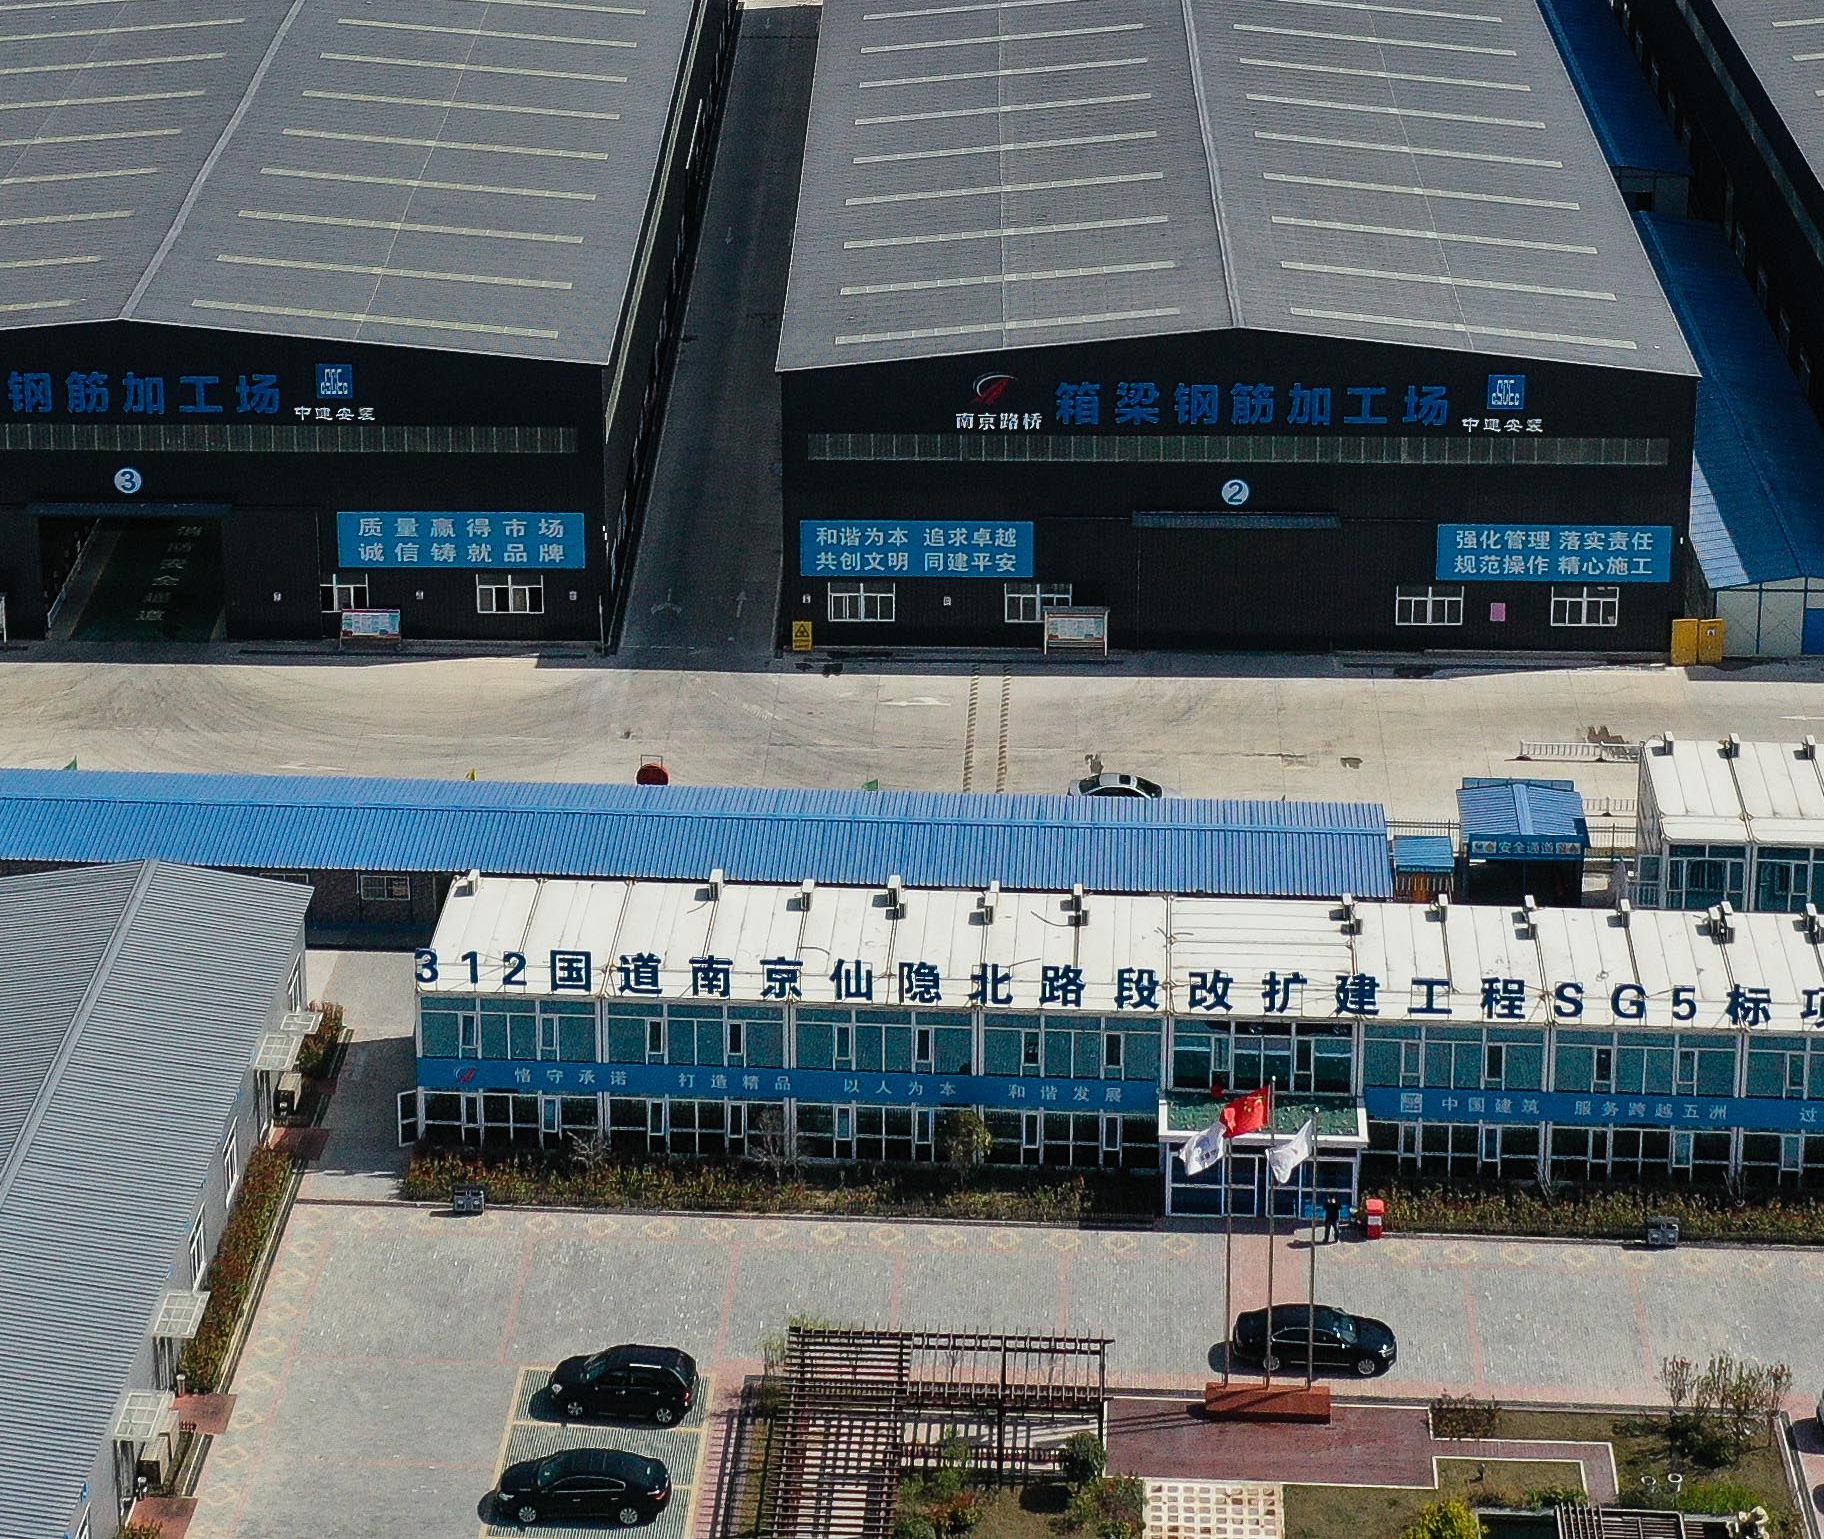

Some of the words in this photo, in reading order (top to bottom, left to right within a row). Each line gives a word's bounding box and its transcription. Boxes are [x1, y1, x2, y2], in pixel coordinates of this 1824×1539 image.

[294, 406, 376, 421] 中建安装
[1056, 380, 1448, 427] 箱梁钢筋加工场
[955, 411, 1043, 430] 南京路桥
[1461, 417, 1544, 433] 中建安装
[119, 469, 136, 491] 3
[1228, 481, 1244, 503] 2
[357, 517, 565, 540] 质量赢得市场
[816, 526, 910, 547] 和谐为本
[923, 526, 1019, 548] 追求卓越
[1455, 529, 1551, 551] 强化管理
[1558, 530, 1654, 553] 落实责任
[357, 542, 565, 566] 诚信铸就品牌
[815, 550, 910, 572] 共创文明
[923, 550, 1019, 572] 同建平安
[1453, 553, 1550, 576] 规范操作
[1556, 554, 1653, 577] 精心施工
[514, 1067, 628, 1086] 恪守承诺
[678, 1073, 792, 1092] 打造精品
[843, 1078, 957, 1098] 以人为本
[1008, 1084, 1123, 1103] 和谐发展
[1441, 1098, 1540, 1115] 中国建筑
[1575, 1101, 1728, 1121] 服务跨越五洲
